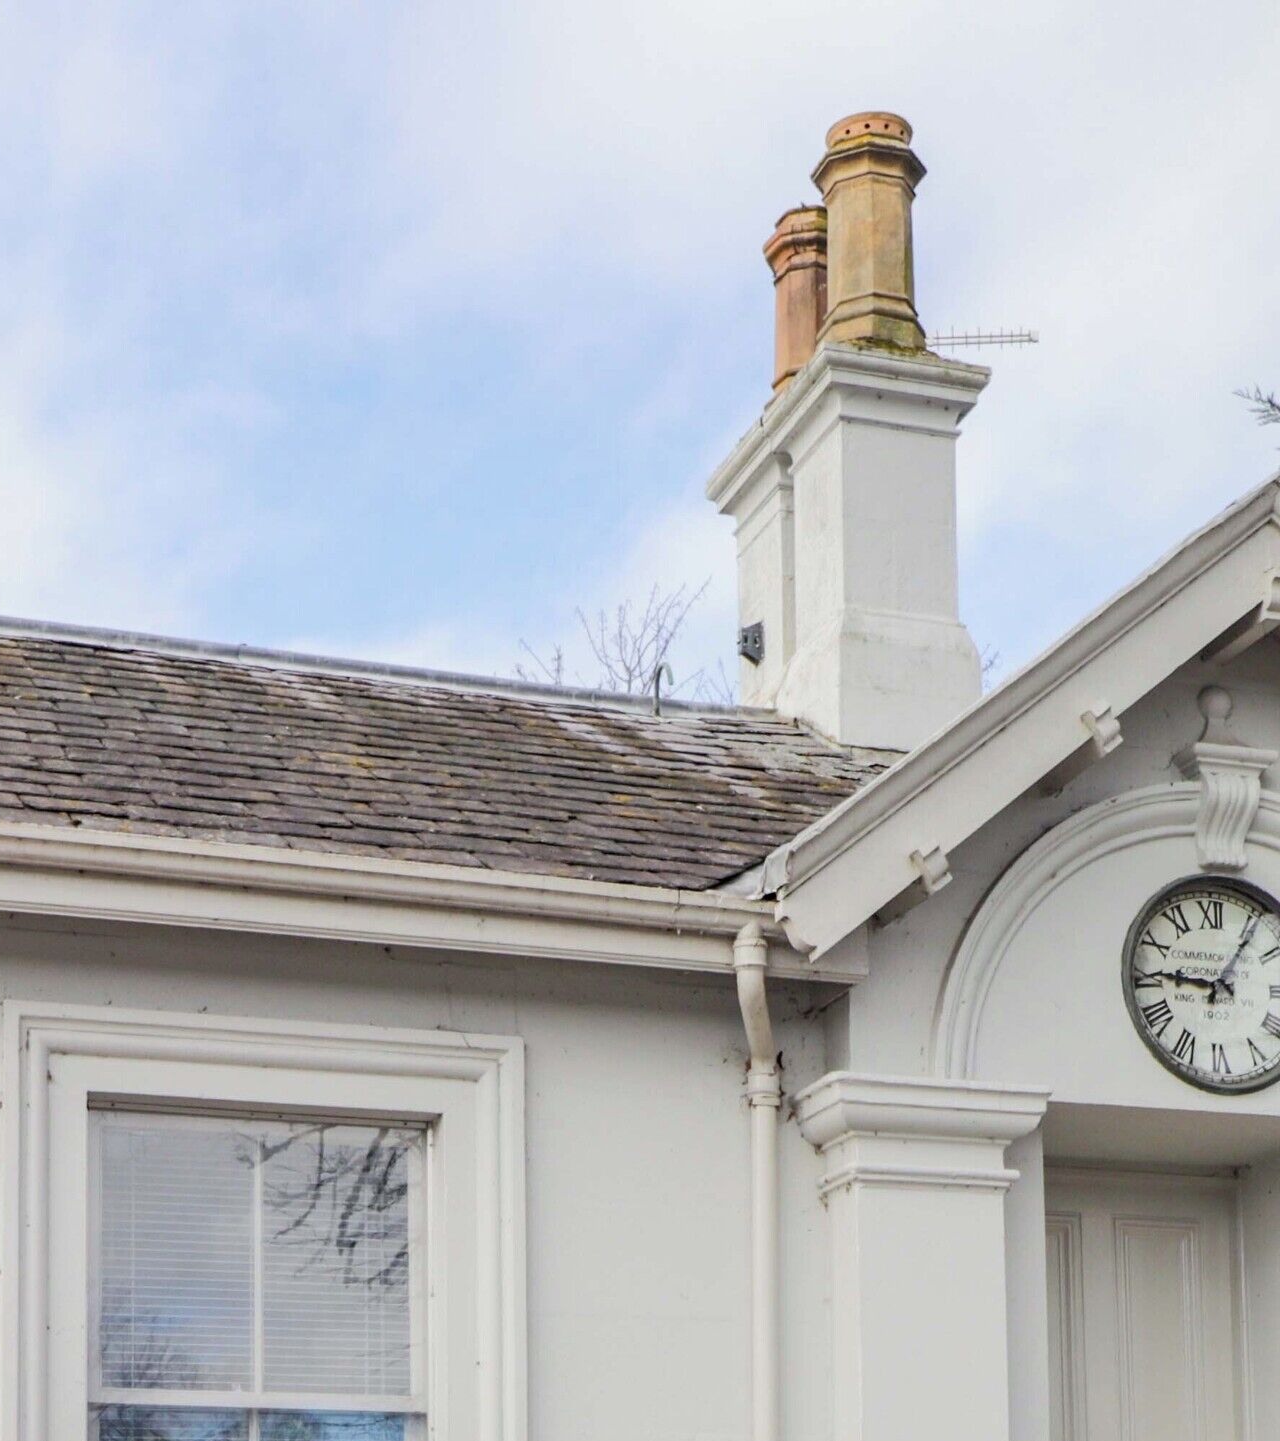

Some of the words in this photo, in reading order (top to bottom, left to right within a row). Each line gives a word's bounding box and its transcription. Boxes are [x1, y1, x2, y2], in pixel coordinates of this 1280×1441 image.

[1163, 904, 1191, 939] XI
[1196, 900, 1224, 930] XII
[1141, 930, 1170, 958] X
[1171, 950, 1254, 965] COMMEMORNG
[1180, 966, 1239, 979] CORONA
[1174, 993, 1195, 1004] KING
[1201, 994, 1235, 1006] EWARD
[1142, 999, 1175, 1038] VIII
[1203, 1010, 1230, 1021] 1902
[1172, 1028, 1197, 1066] VII
[1212, 1043, 1232, 1075] VI
[1247, 1037, 1268, 1067] V
